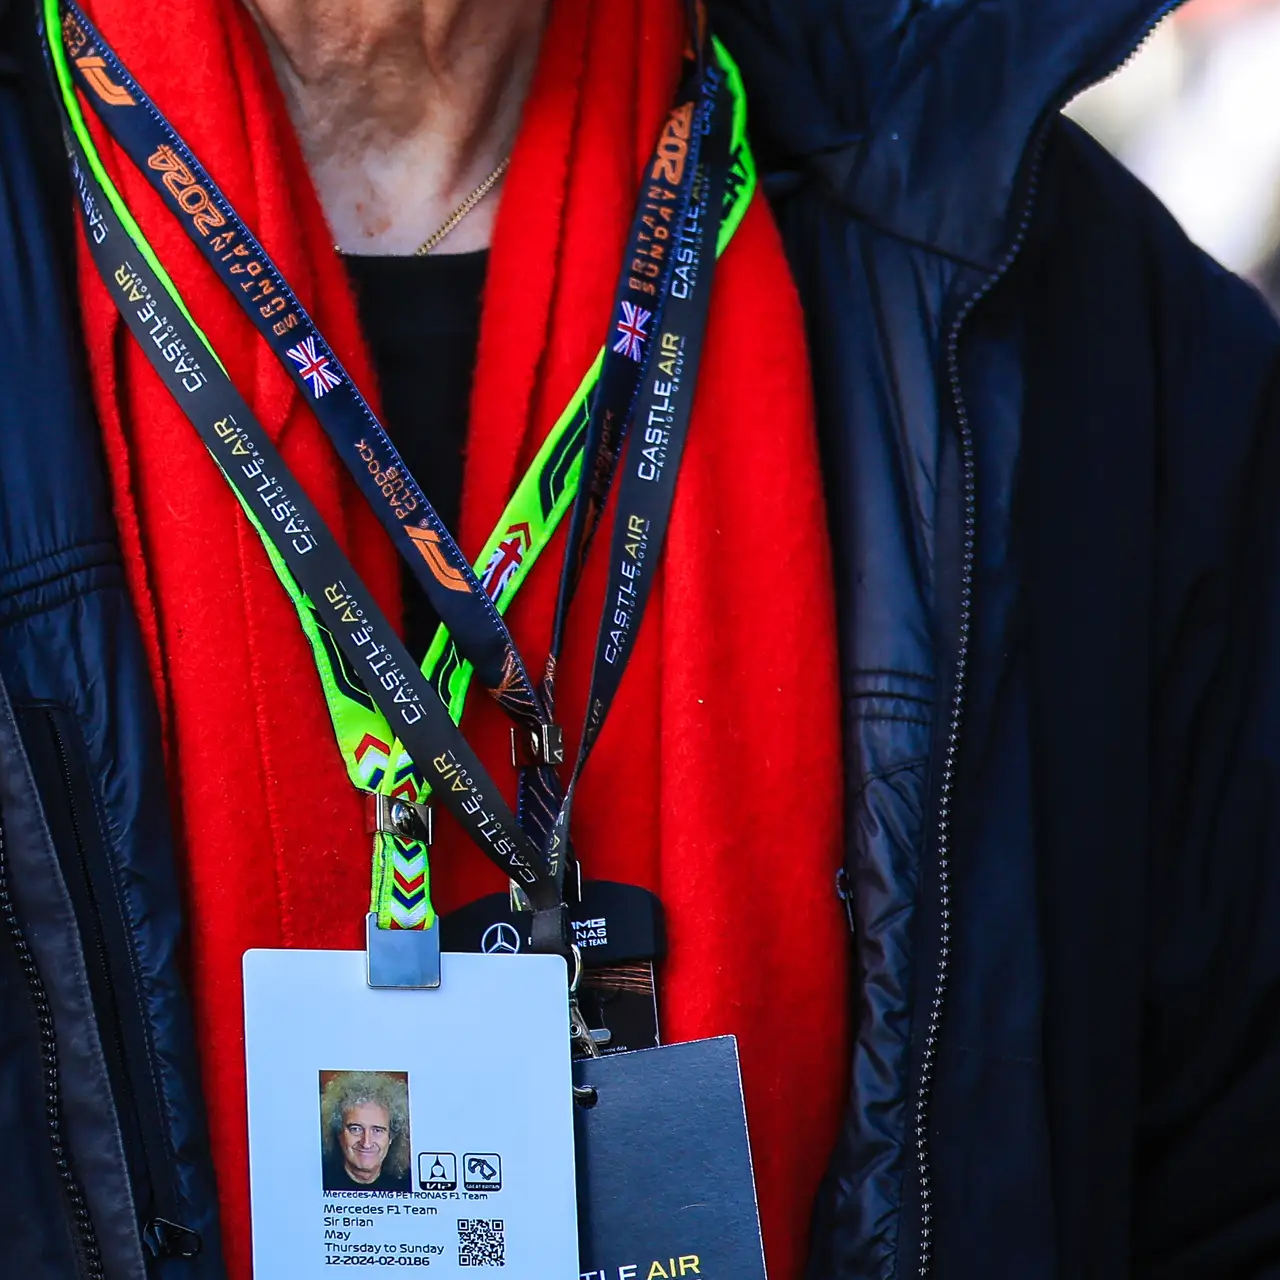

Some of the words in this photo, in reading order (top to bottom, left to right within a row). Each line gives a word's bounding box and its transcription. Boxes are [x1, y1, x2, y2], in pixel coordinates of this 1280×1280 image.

[147, 143, 227, 237] 2024
[628, 185, 663, 291] BRITAIN
[642, 189, 677, 297] SUNDAY
[671, 206, 700, 300] CASTLE
[114, 264, 145, 302] AIR
[131, 272, 157, 308] GROUP
[209, 235, 290, 336] BRITAIN
[220, 230, 298, 332] SUNDAY
[137, 303, 204, 392] CASTLE
[161, 315, 200, 370] AVIATION
[638, 379, 672, 481] CASTLE
[658, 332, 680, 376] AIR
[214, 417, 250, 456] AIR
[236, 427, 265, 465] GROUP
[657, 406, 675, 468] AVIATION
[354, 438, 409, 520] PADDOCK
[385, 466, 419, 512] CLUB
[241, 459, 314, 555] CASTLE
[269, 476, 311, 532] AVIATION
[324, 583, 360, 623] AIR
[345, 593, 374, 632] GROUP
[604, 561, 637, 664] CASTLE
[624, 515, 645, 559] AIR
[351, 627, 423, 724] CASTLE
[379, 644, 419, 702] AVIATION
[433, 752, 469, 793] AIR
[454, 761, 484, 802] GROUP
[462, 795, 537, 883] CASTLE
[548, 834, 561, 877] AIR
[589, 938, 608, 946] TEAM
[323, 1190, 394, 1199] Mercedes-AMG
[396, 1191, 448, 1200] PETRONAS
[449, 1191, 460, 1200] F1
[462, 1191, 488, 1200] Team
[324, 1204, 384, 1214] Mercedes
[387, 1205, 401, 1215] F1
[403, 1205, 438, 1215] Team
[324, 1216, 341, 1227] Sir
[343, 1217, 373, 1227] Brian
[324, 1229, 351, 1241] May
[325, 1242, 381, 1254] Thursday
[384, 1244, 397, 1253] to
[399, 1243, 445, 1255] Sunday
[325, 1255, 430, 1266] 12-2024-02-0186
[647, 1254, 701, 1280] AIR
